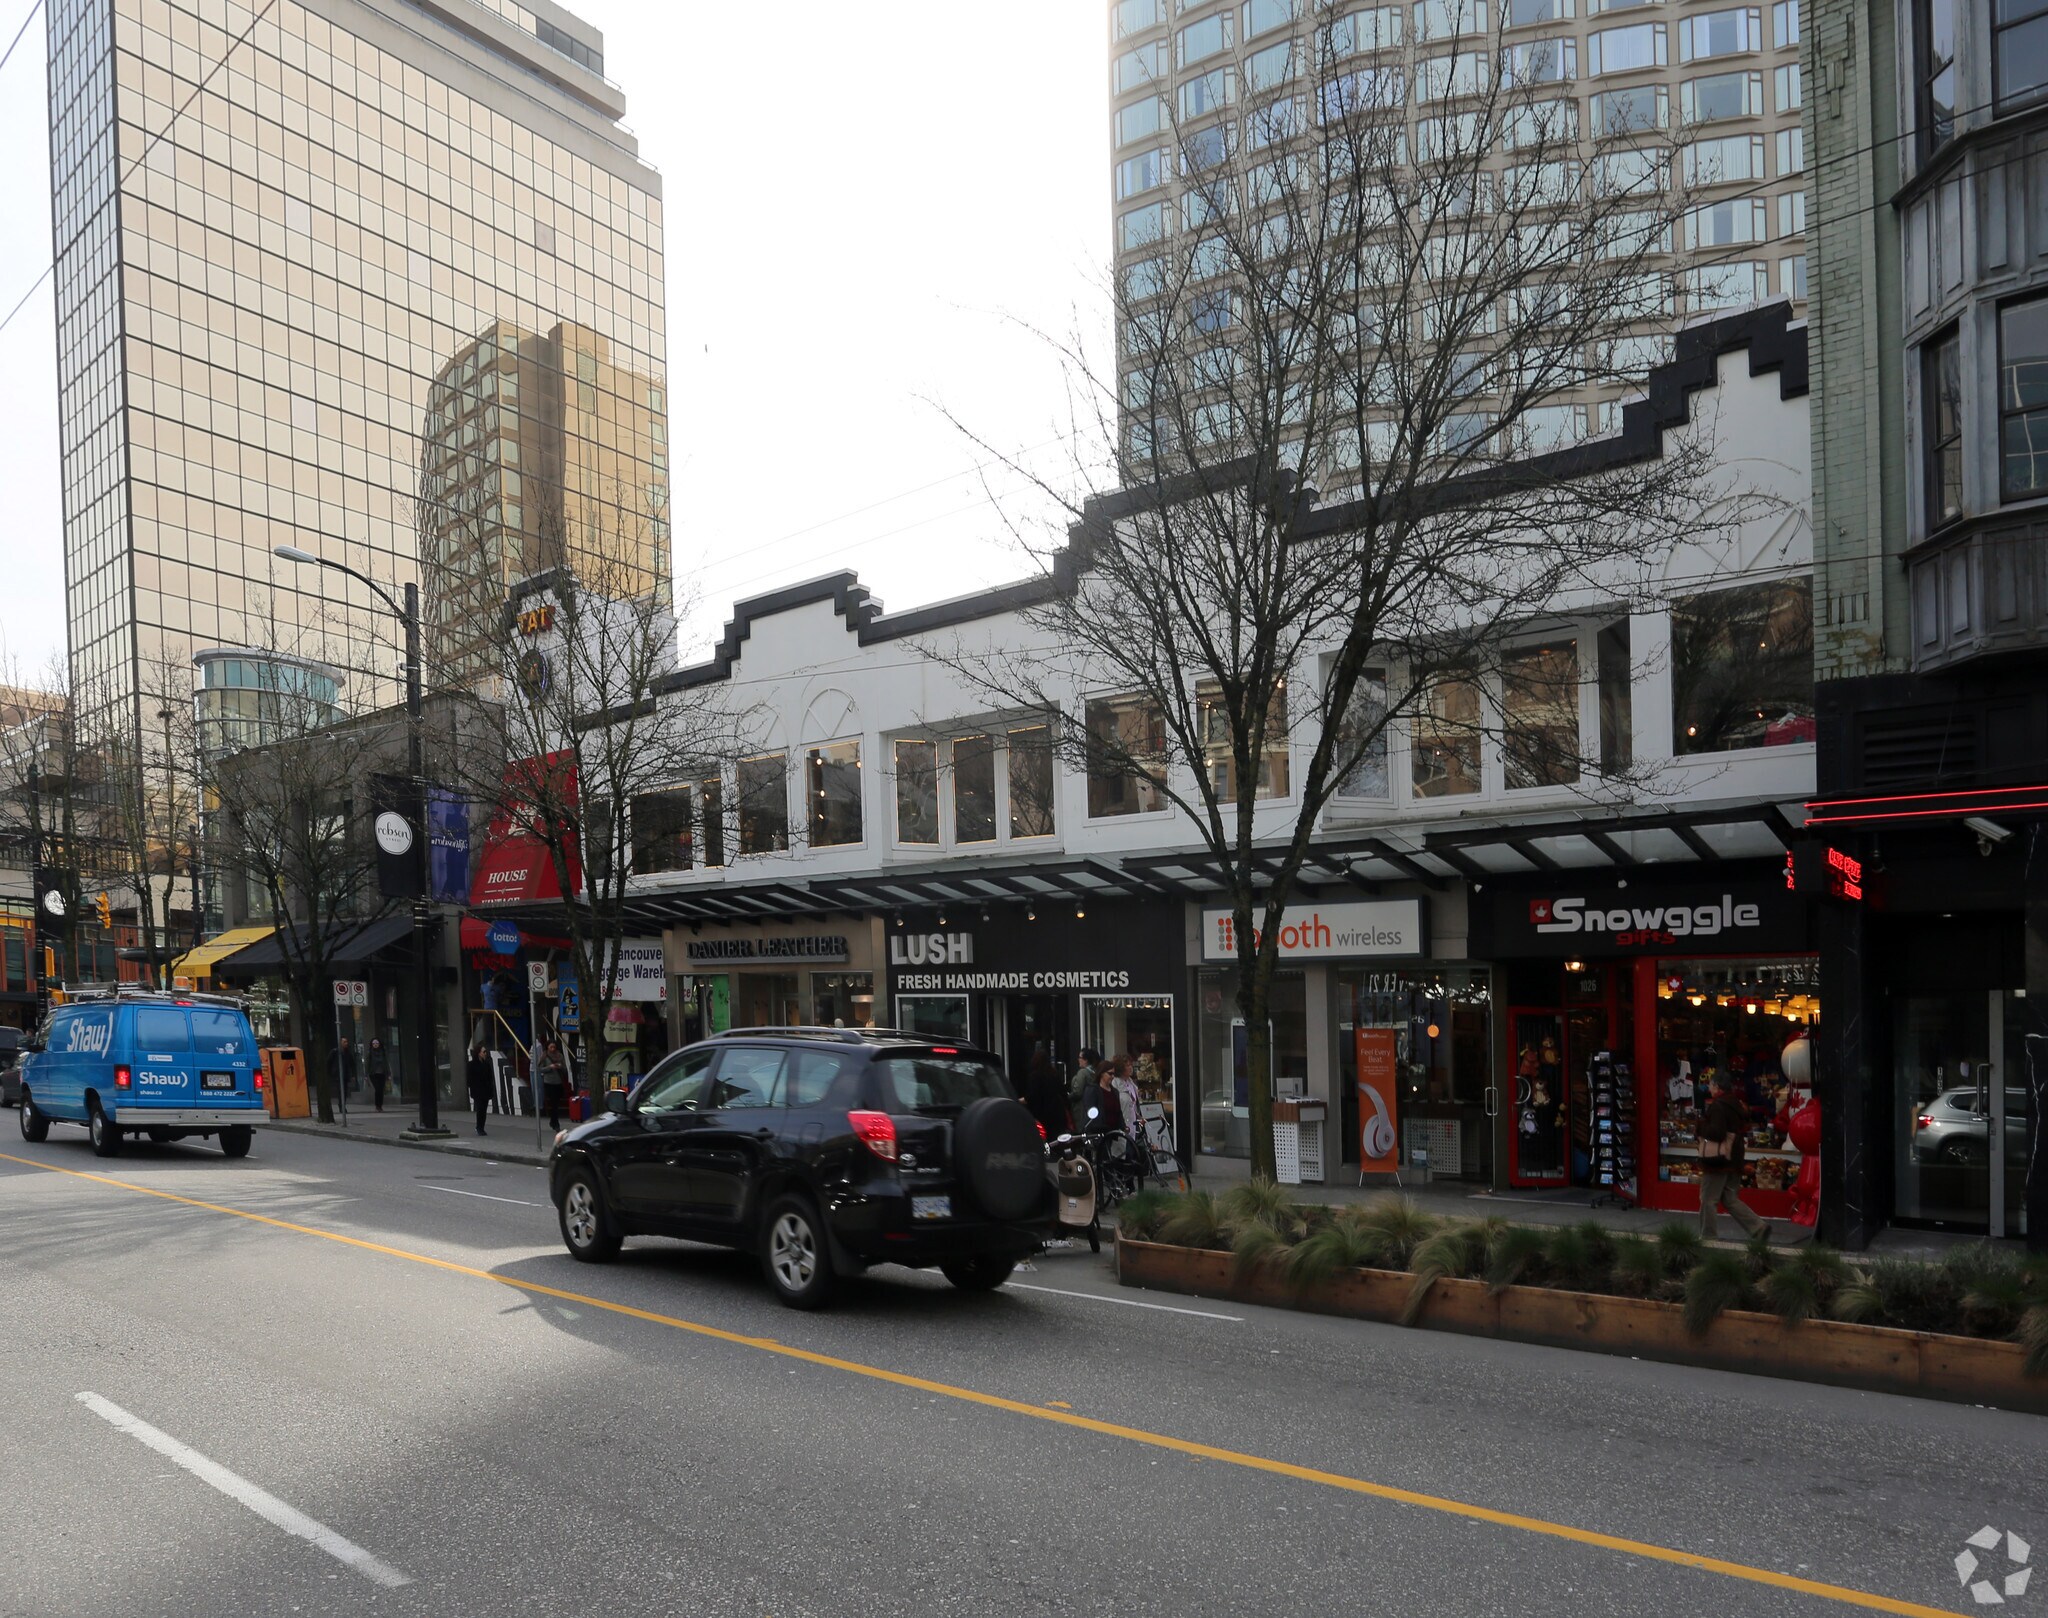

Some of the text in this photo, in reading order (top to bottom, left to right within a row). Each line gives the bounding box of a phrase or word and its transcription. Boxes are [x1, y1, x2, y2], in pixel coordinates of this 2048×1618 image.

[377, 821, 411, 841] robson
[487, 869, 528, 884] HOUSE
[1537, 894, 1760, 936] Snowggle
[1337, 926, 1402, 947] wireless
[1616, 930, 1677, 946] gifts
[686, 936, 848, 959] DANIER LEATHER
[891, 932, 973, 965] LUSH
[897, 971, 1130, 989] FRESH HANDMADE COSMETICS
[1580, 979, 1597, 992] 1026
[1360, 1048, 1391, 1057] Feel Every
